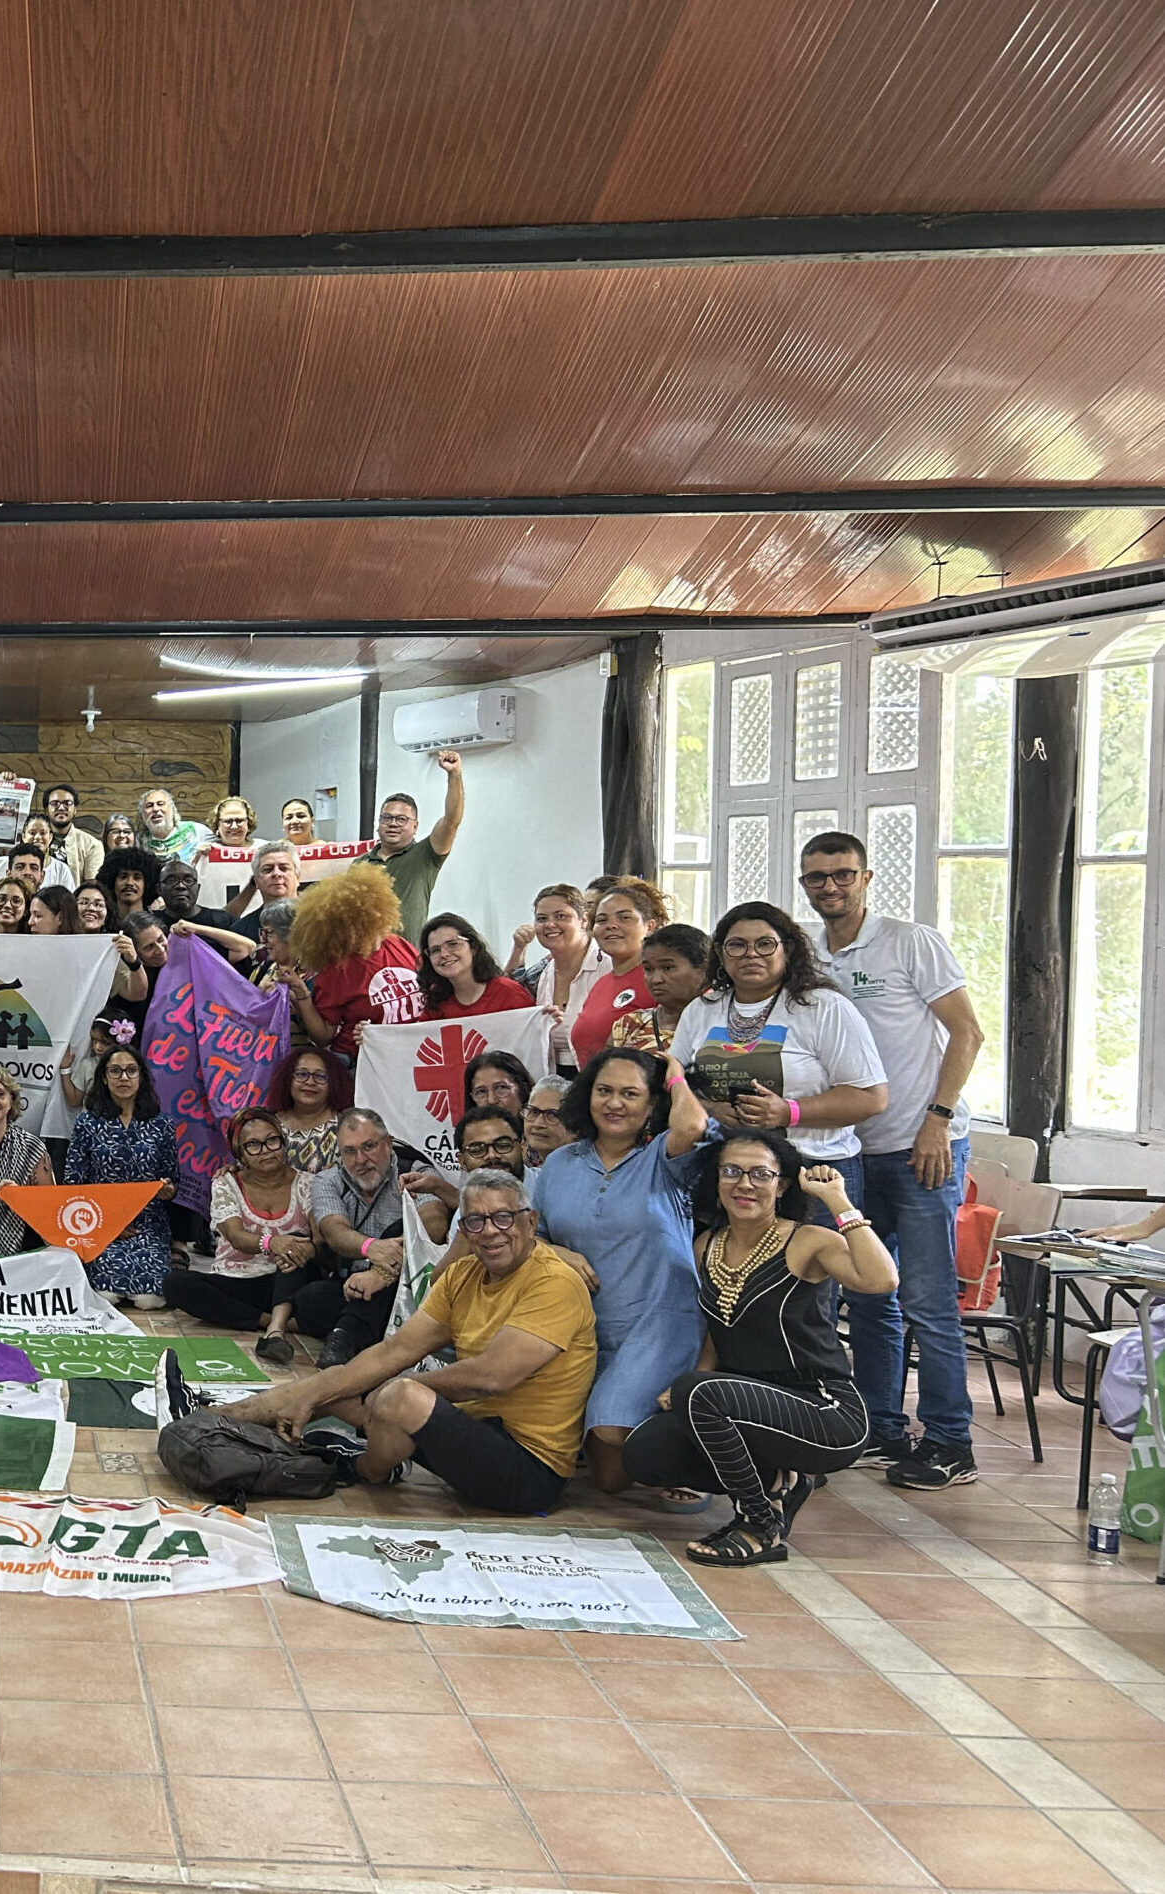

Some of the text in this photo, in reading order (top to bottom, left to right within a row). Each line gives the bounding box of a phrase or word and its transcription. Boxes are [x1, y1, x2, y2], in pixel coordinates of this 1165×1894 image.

[220, 847, 249, 860] UGT
[329, 843, 359, 856] UGT
[382, 992, 425, 1025] MLB
[31, 1348, 159, 1360] OWER
[48, 1514, 209, 1561] GTA
[83, 1554, 139, 1565] TRABALHO
[464, 1550, 516, 1564] REDE
[97, 1571, 109, 1581] O
[112, 1572, 172, 1583] MUNDO
[442, 1593, 493, 1605] sobre
